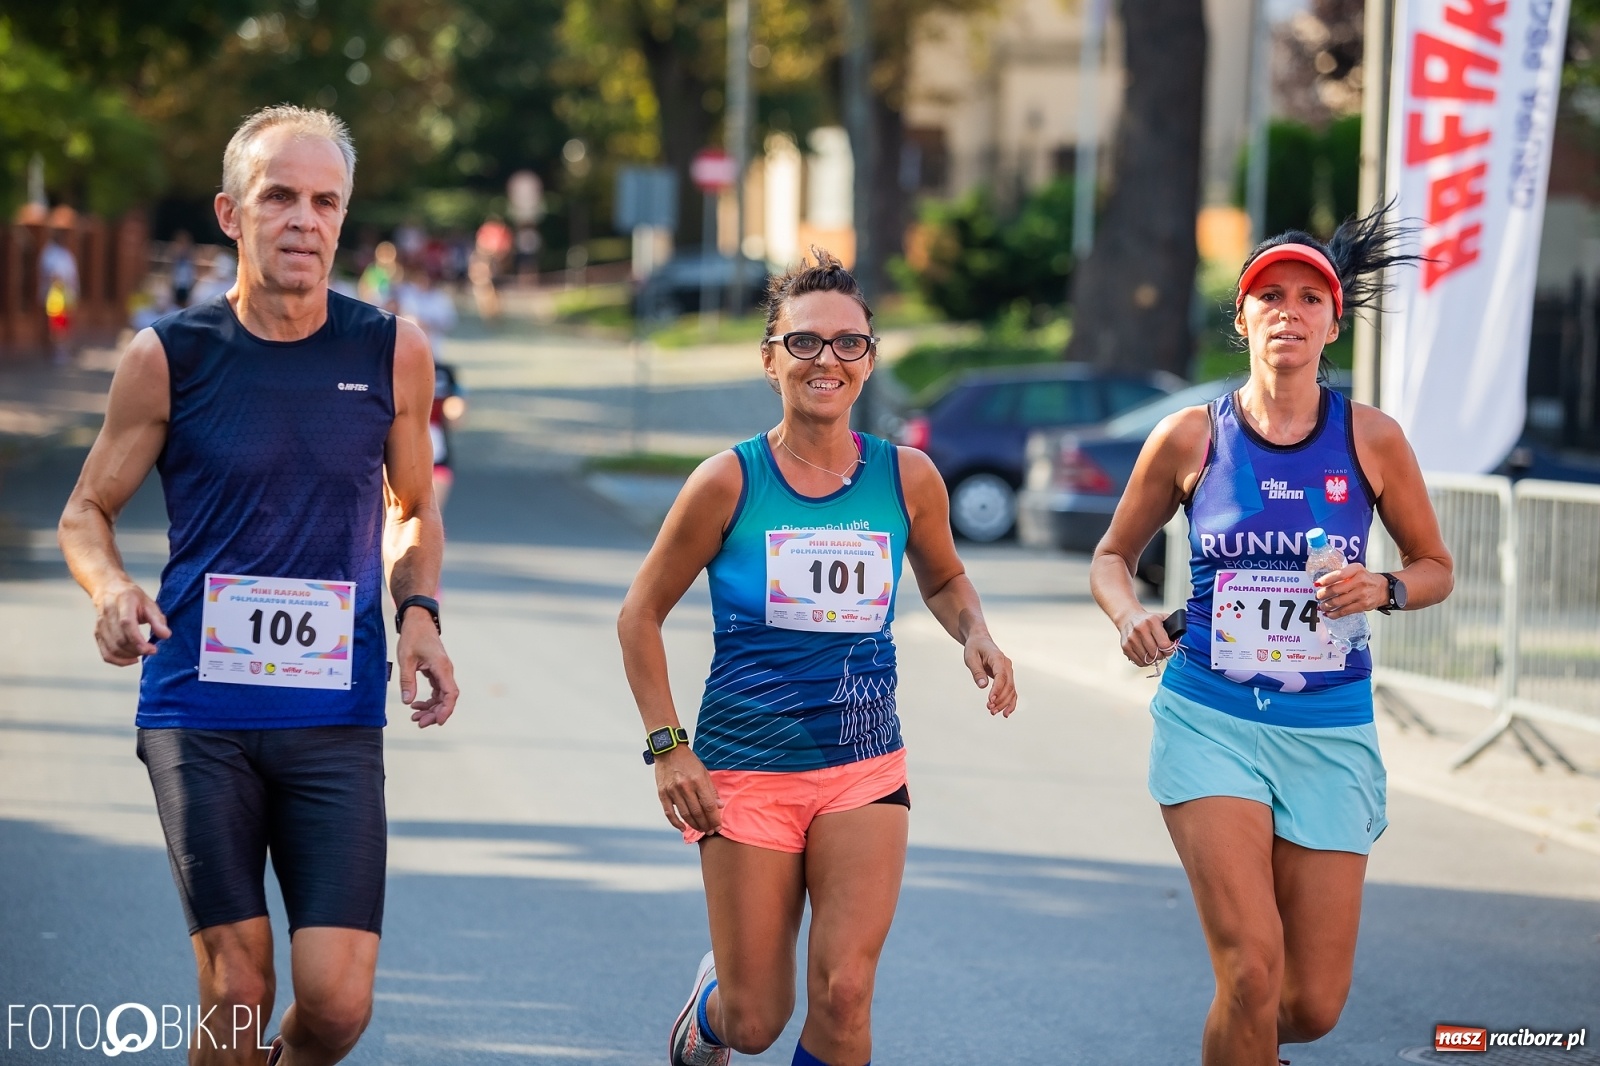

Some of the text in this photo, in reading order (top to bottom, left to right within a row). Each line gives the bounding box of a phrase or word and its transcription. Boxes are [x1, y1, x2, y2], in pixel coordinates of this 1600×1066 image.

[1200, 531, 1361, 563] RUNNRS
[1223, 560, 1299, 570] EKO-OKNA
[808, 560, 865, 594] 101
[1261, 575, 1300, 583] RAFAKO
[251, 587, 311, 597] MINI RAFAKO
[1283, 586, 1317, 594] RACIBÓ
[1258, 598, 1320, 632] 174
[248, 608, 317, 647] 106
[1267, 634, 1301, 643] PATRYCJA
